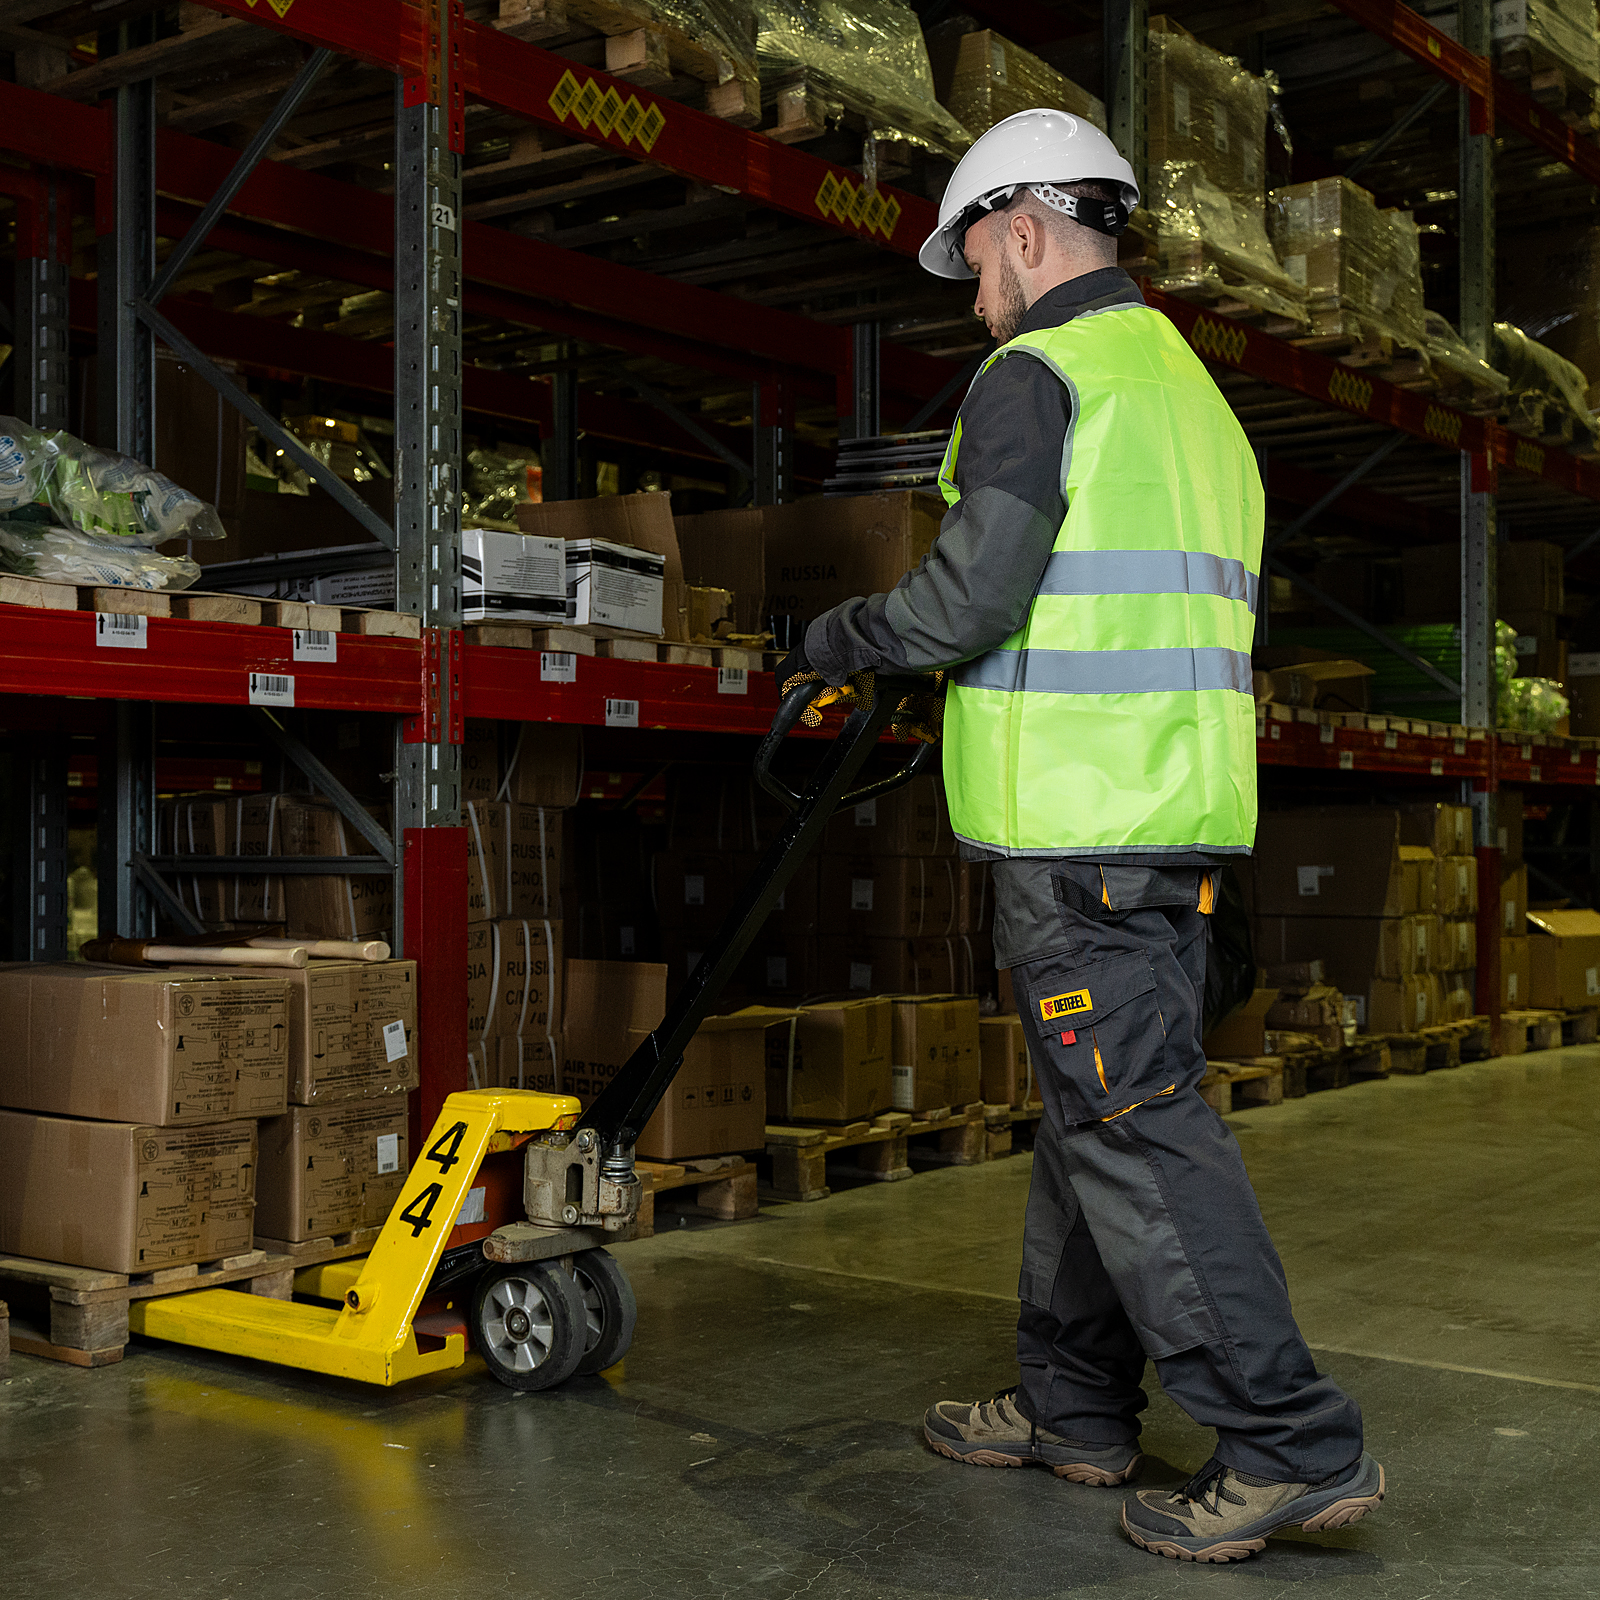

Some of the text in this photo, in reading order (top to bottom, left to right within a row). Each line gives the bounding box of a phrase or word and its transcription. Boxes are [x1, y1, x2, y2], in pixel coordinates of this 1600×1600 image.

[436, 207, 449, 225] 21
[781, 565, 837, 582] RUSSIA
[763, 594, 804, 611] /NO:
[464, 727, 494, 742] SSIA
[511, 843, 555, 860] RUSSA
[563, 1060, 585, 1075] AIR
